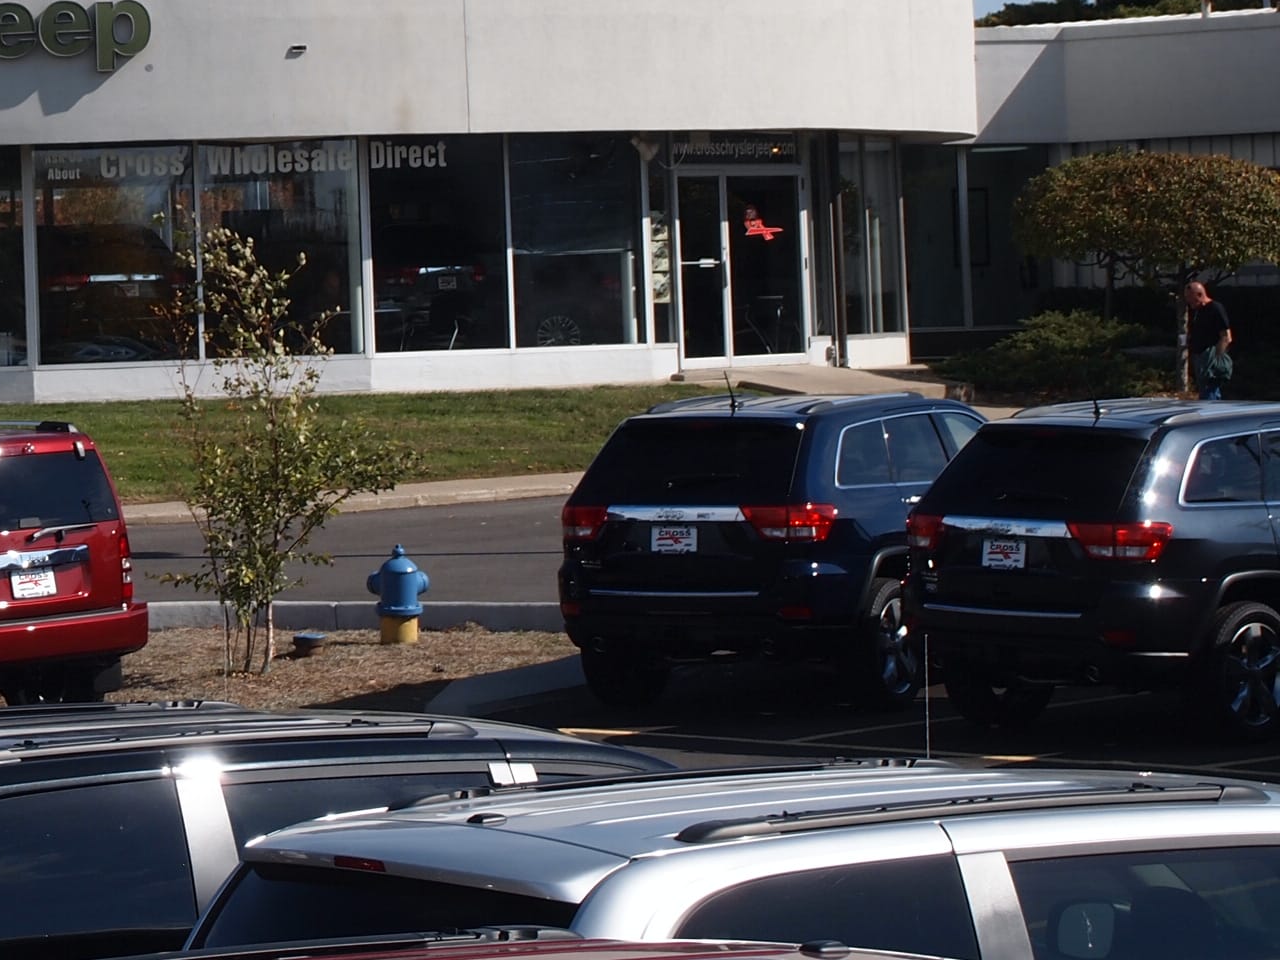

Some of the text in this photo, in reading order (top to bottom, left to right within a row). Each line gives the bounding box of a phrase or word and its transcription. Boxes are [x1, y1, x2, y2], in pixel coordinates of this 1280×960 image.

[99, 140, 448, 179] Cross Wholesale Direct
[47, 167, 81, 181] About
[658, 529, 692, 537] CROSS
[991, 543, 1021, 552] CROSS
